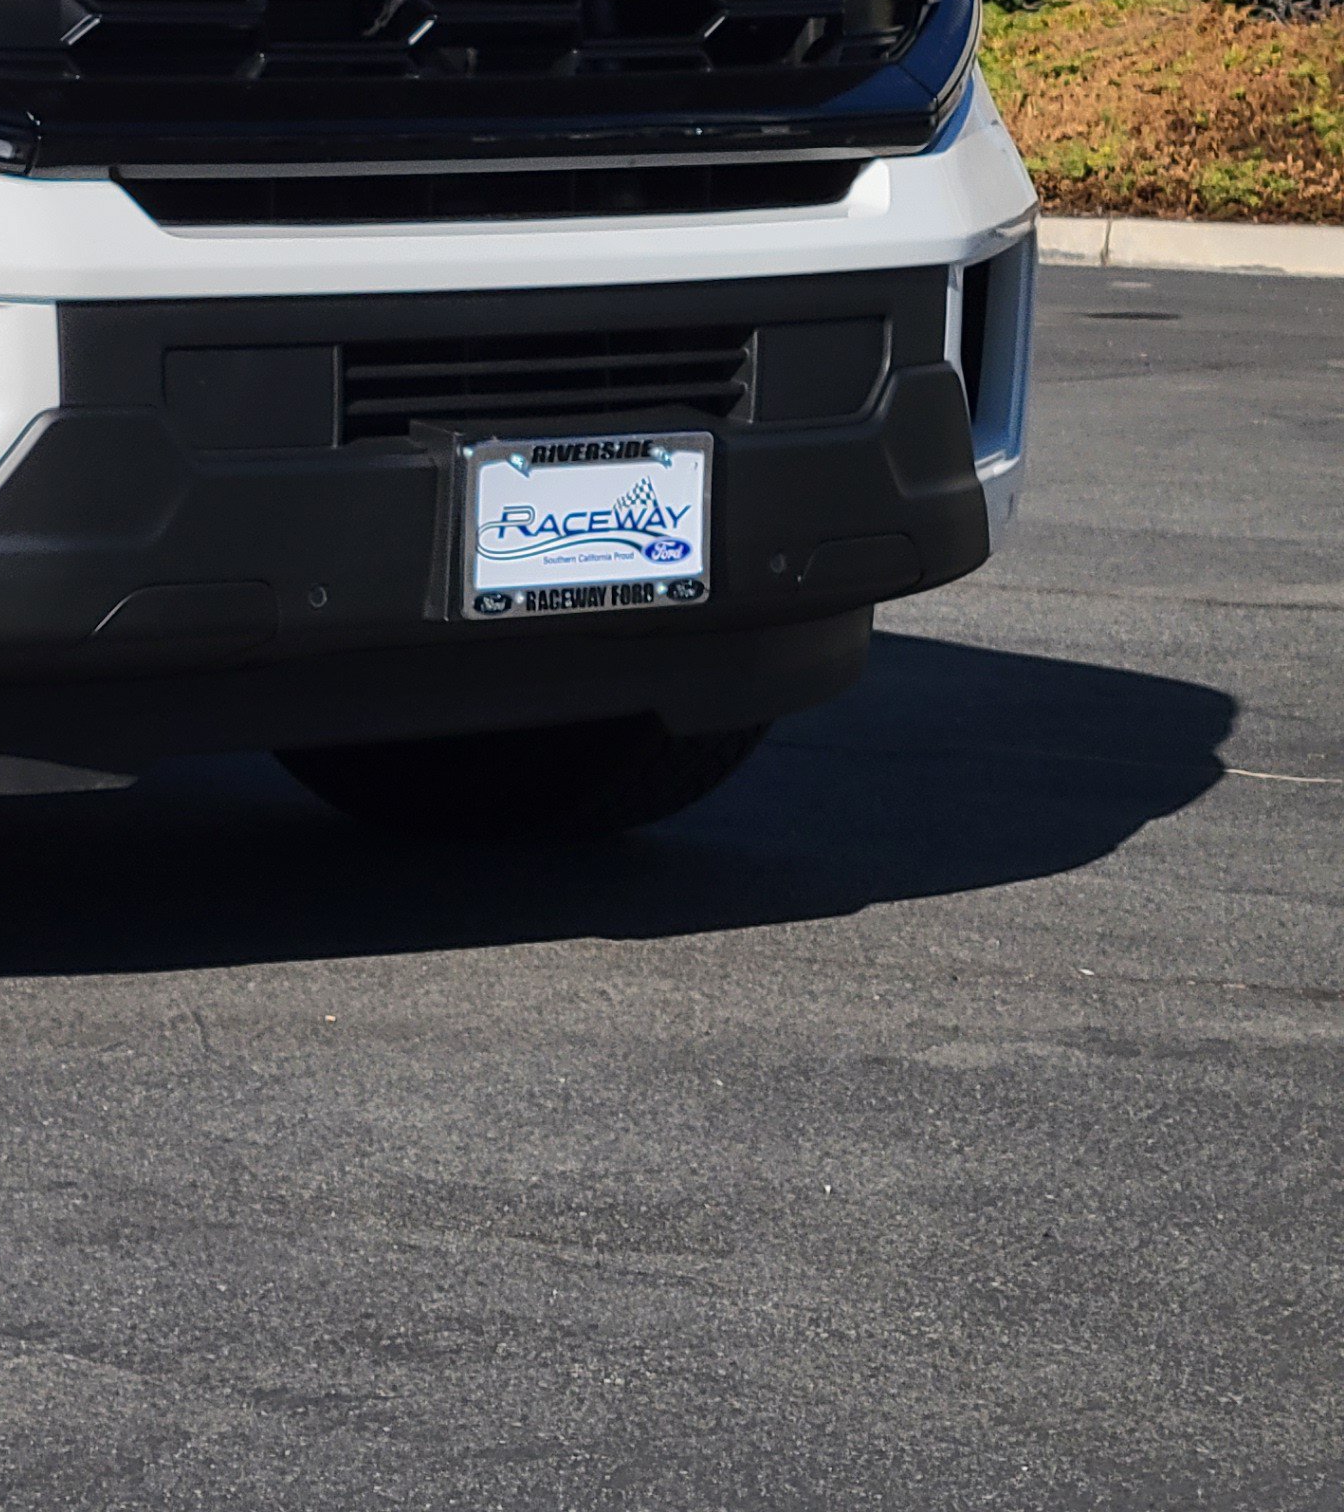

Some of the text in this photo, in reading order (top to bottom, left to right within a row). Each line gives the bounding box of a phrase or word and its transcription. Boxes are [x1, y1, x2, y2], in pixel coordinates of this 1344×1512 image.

[531, 440, 654, 464] RIVERSIDE
[495, 505, 692, 539] RACEWAY
[543, 551, 635, 565] Southern California Proud
[651, 540, 684, 561] Ford
[526, 586, 608, 612] RACEWAY
[612, 583, 655, 606] FORD
